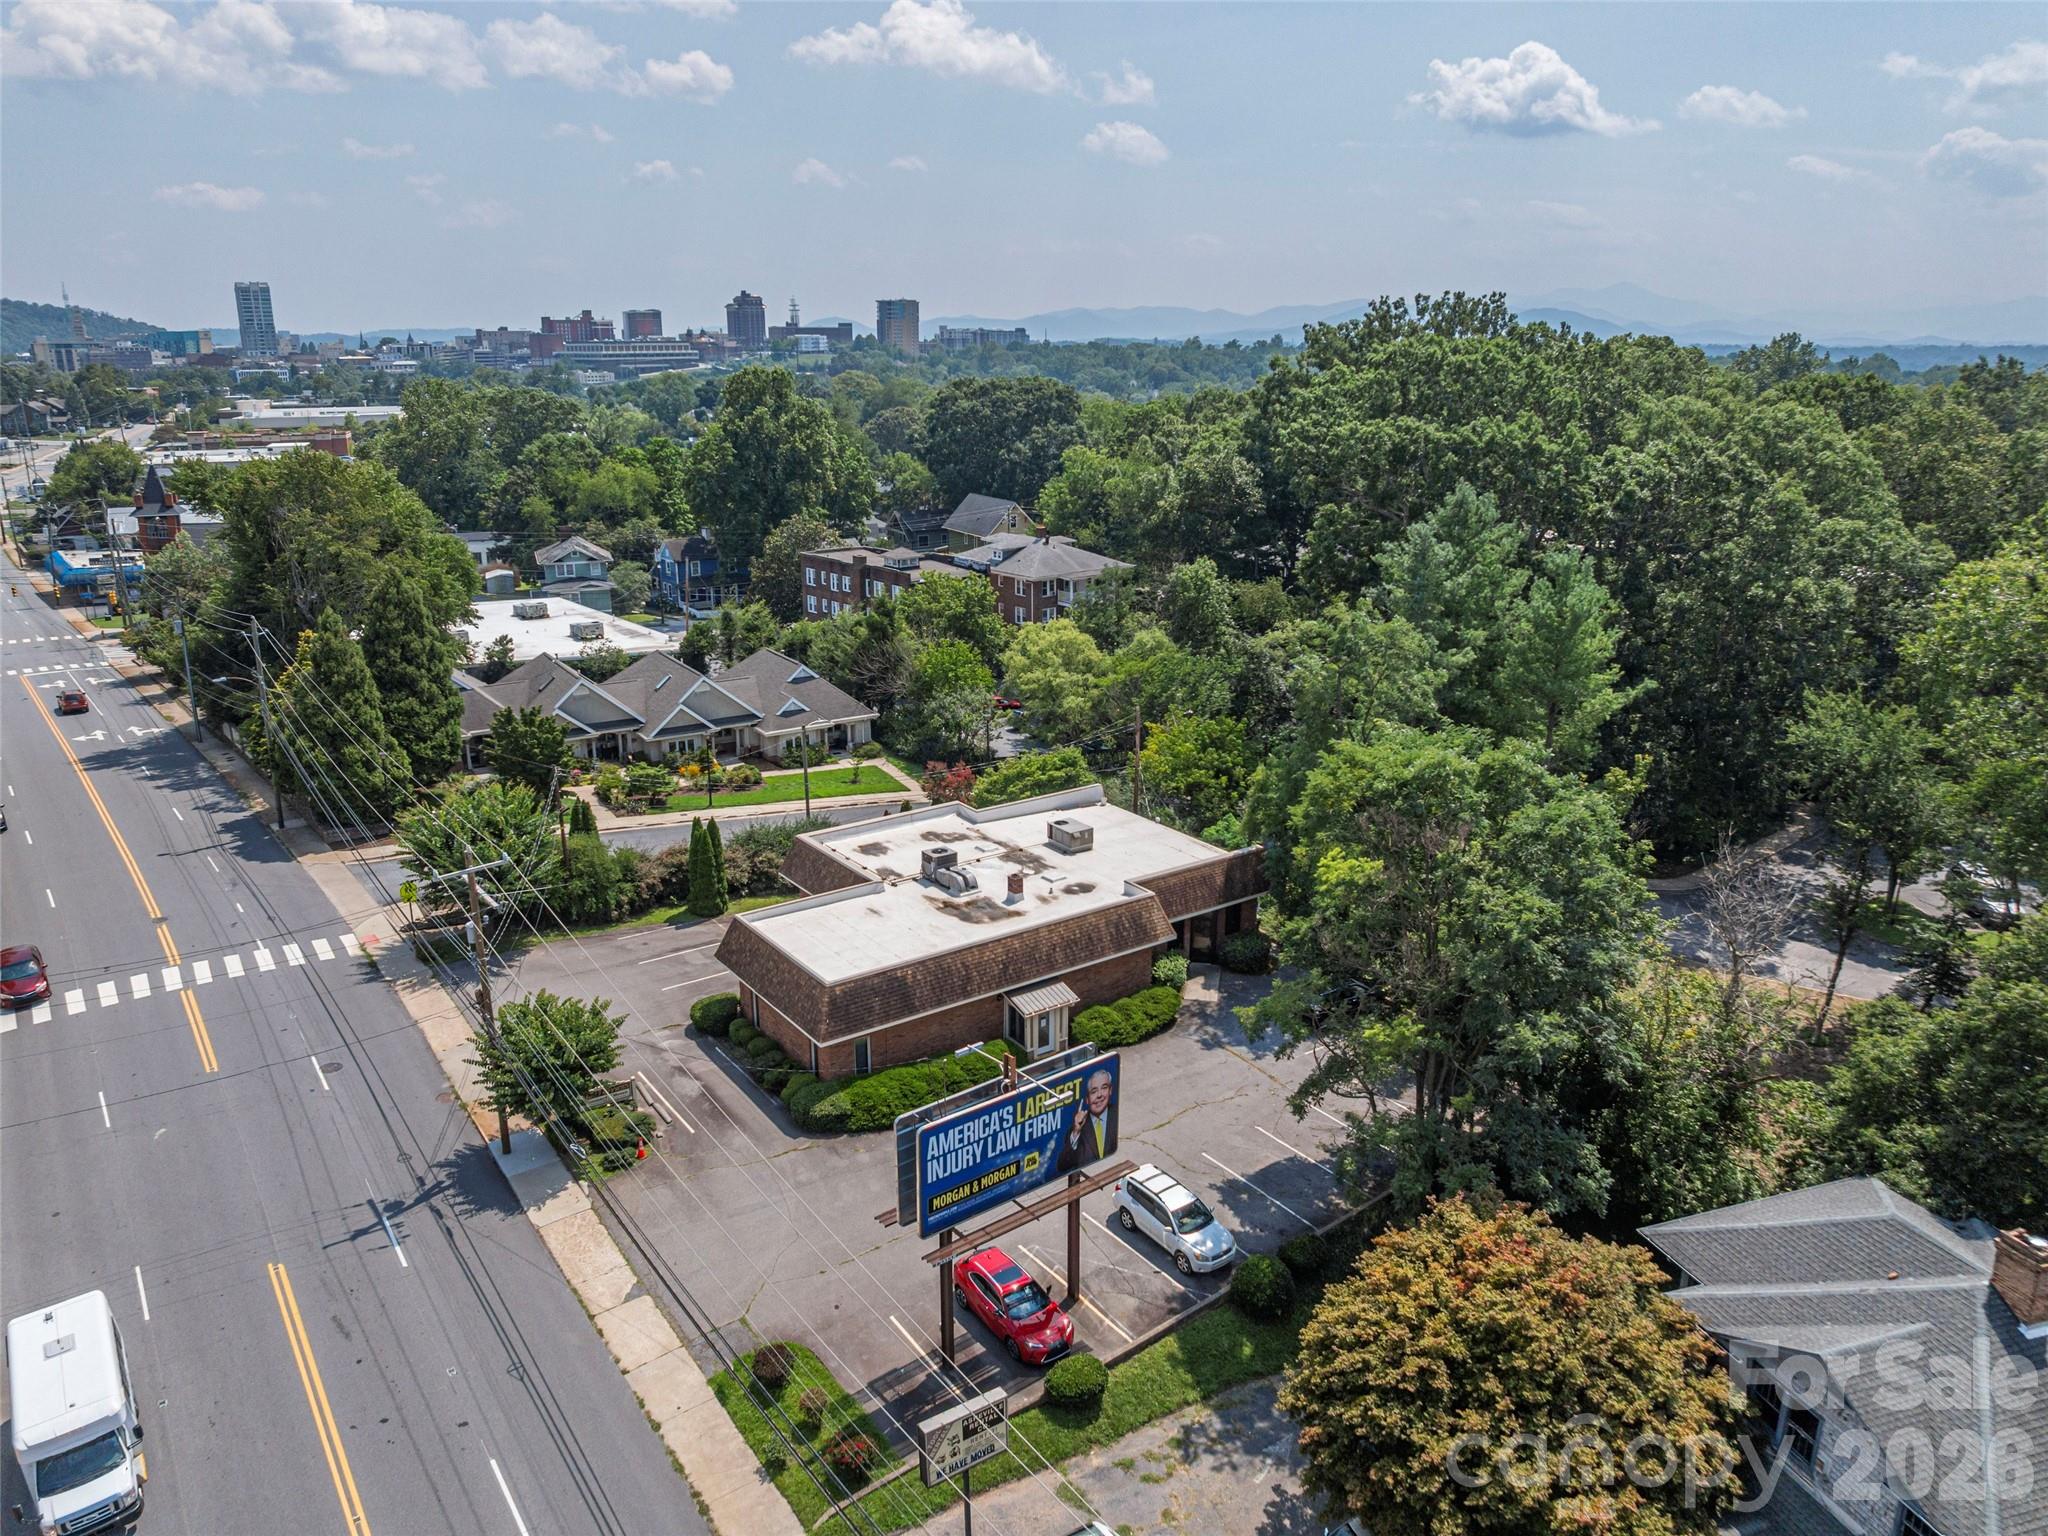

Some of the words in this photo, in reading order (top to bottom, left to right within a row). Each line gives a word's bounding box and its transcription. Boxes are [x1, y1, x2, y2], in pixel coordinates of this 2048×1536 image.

[927, 1105, 1013, 1160] AMERICA'S
[1016, 1077, 1083, 1123] LARGEST
[927, 1140, 984, 1184] INJURY
[987, 1124, 1021, 1158] LAW
[1024, 1108, 1061, 1142] FIRM
[932, 1185, 971, 1211] MORGAN
[972, 1180, 980, 1193] &
[981, 1163, 1017, 1189] MORGAN
[949, 1456, 968, 1474] HAVE
[970, 1443, 996, 1463] MOVED
